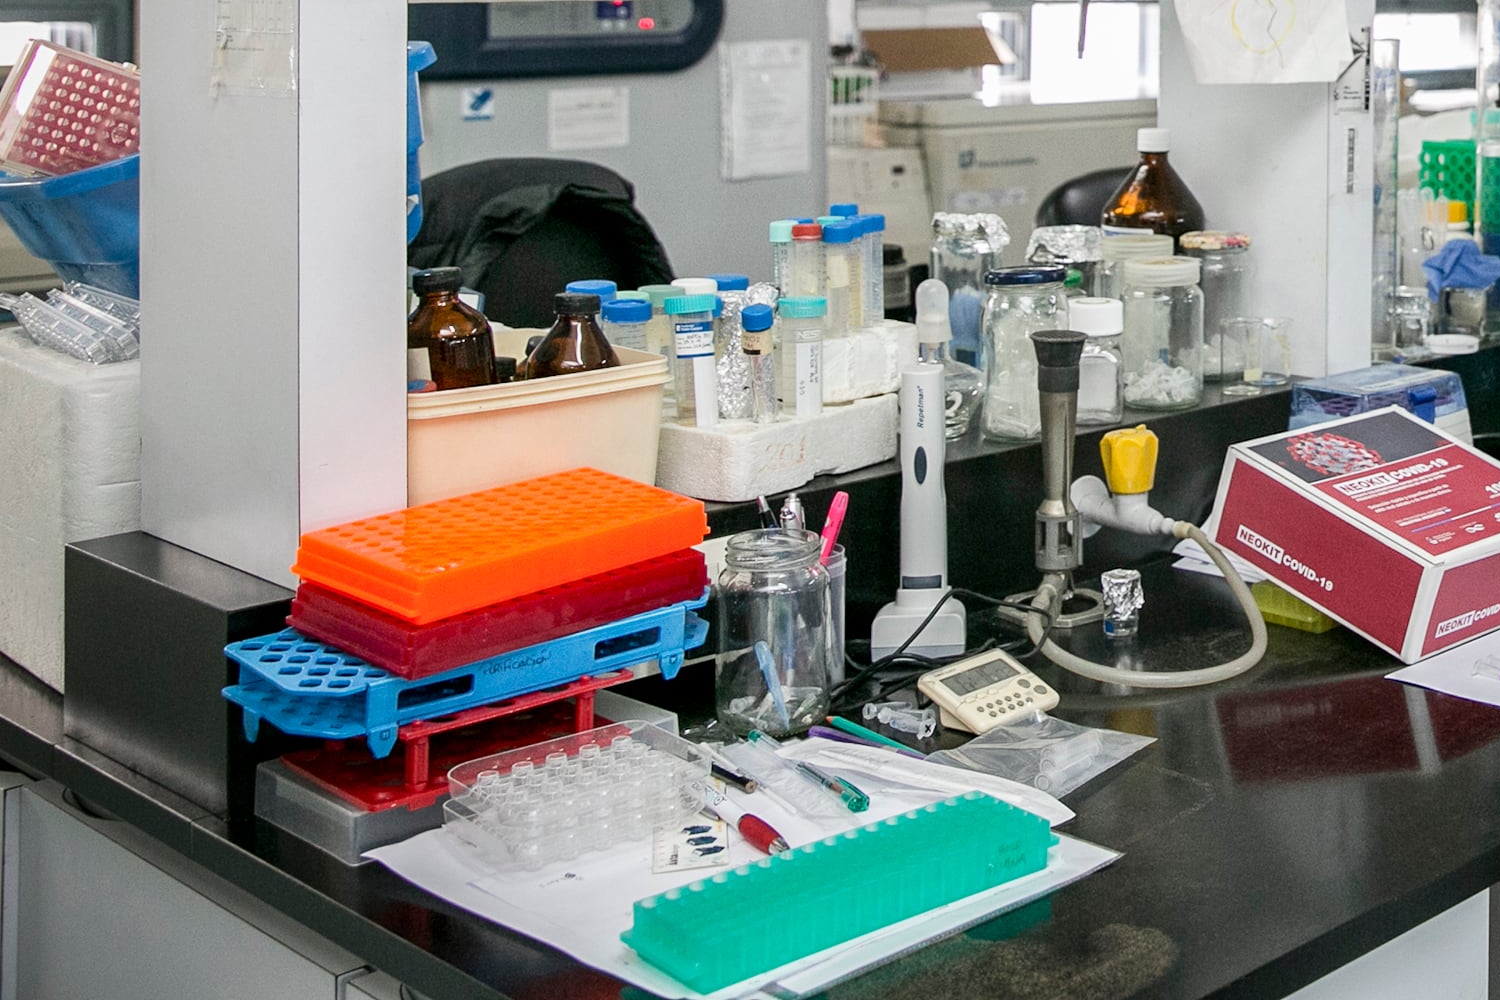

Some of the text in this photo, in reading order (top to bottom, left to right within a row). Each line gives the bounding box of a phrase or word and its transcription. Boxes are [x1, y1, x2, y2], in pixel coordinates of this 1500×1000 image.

[1339, 473, 1392, 495] NEOKIT
[1389, 458, 1449, 481] COVID-19
[1240, 529, 1334, 592] NEOKIT COVID-19
[1438, 614, 1472, 634] NEOKIT
